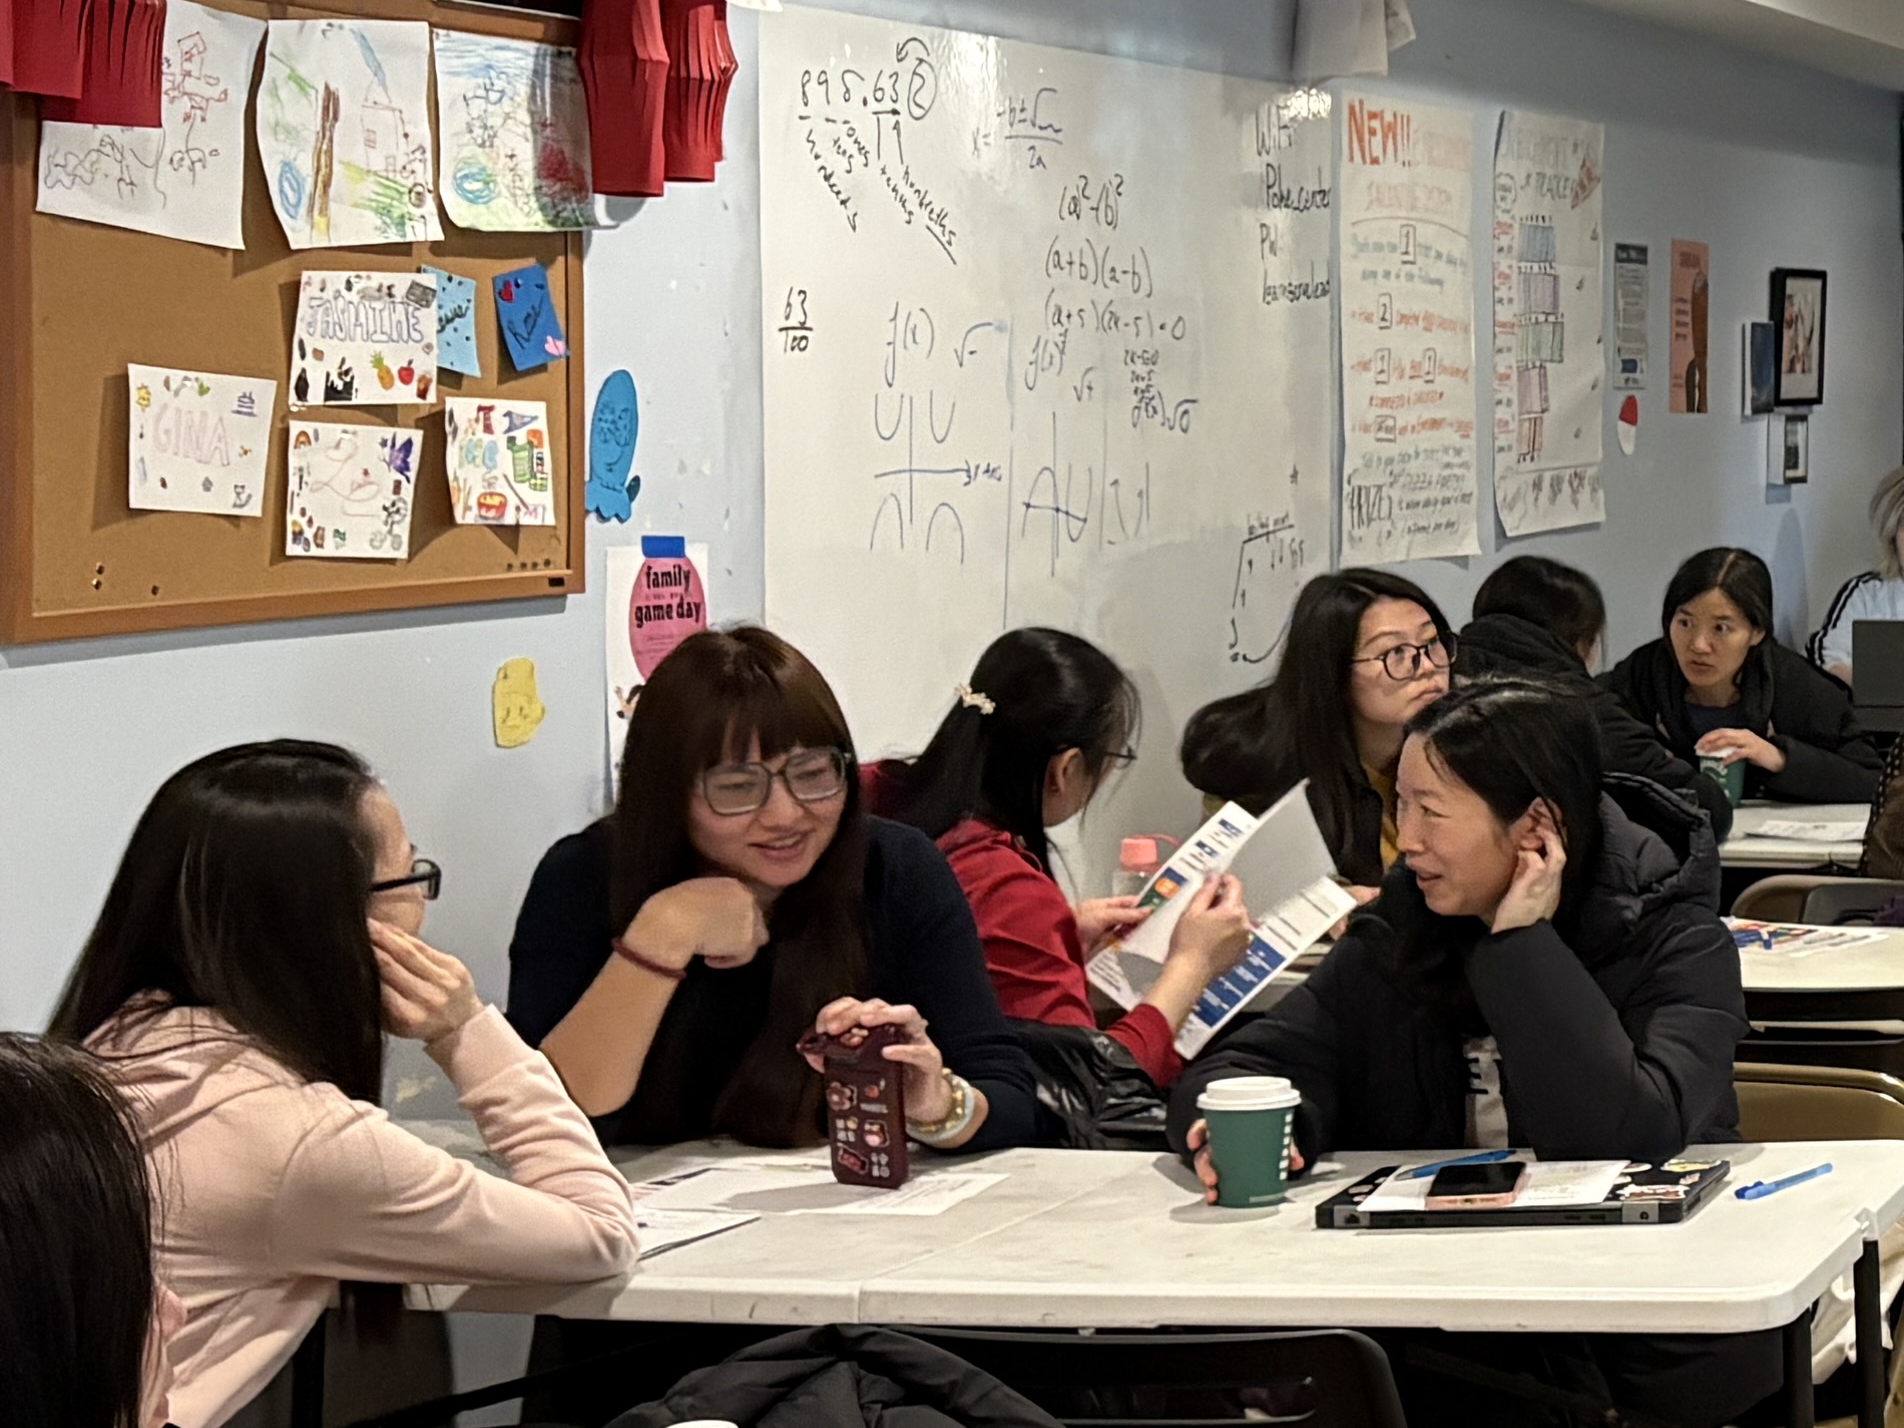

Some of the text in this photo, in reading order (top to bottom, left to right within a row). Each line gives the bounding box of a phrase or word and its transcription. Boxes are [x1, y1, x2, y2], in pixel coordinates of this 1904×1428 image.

[1348, 98, 1411, 167] NEW!!
[785, 286, 807, 326] 63
[152, 402, 231, 467] GINA
[645, 564, 690, 592] family
[634, 595, 702, 628] game day
